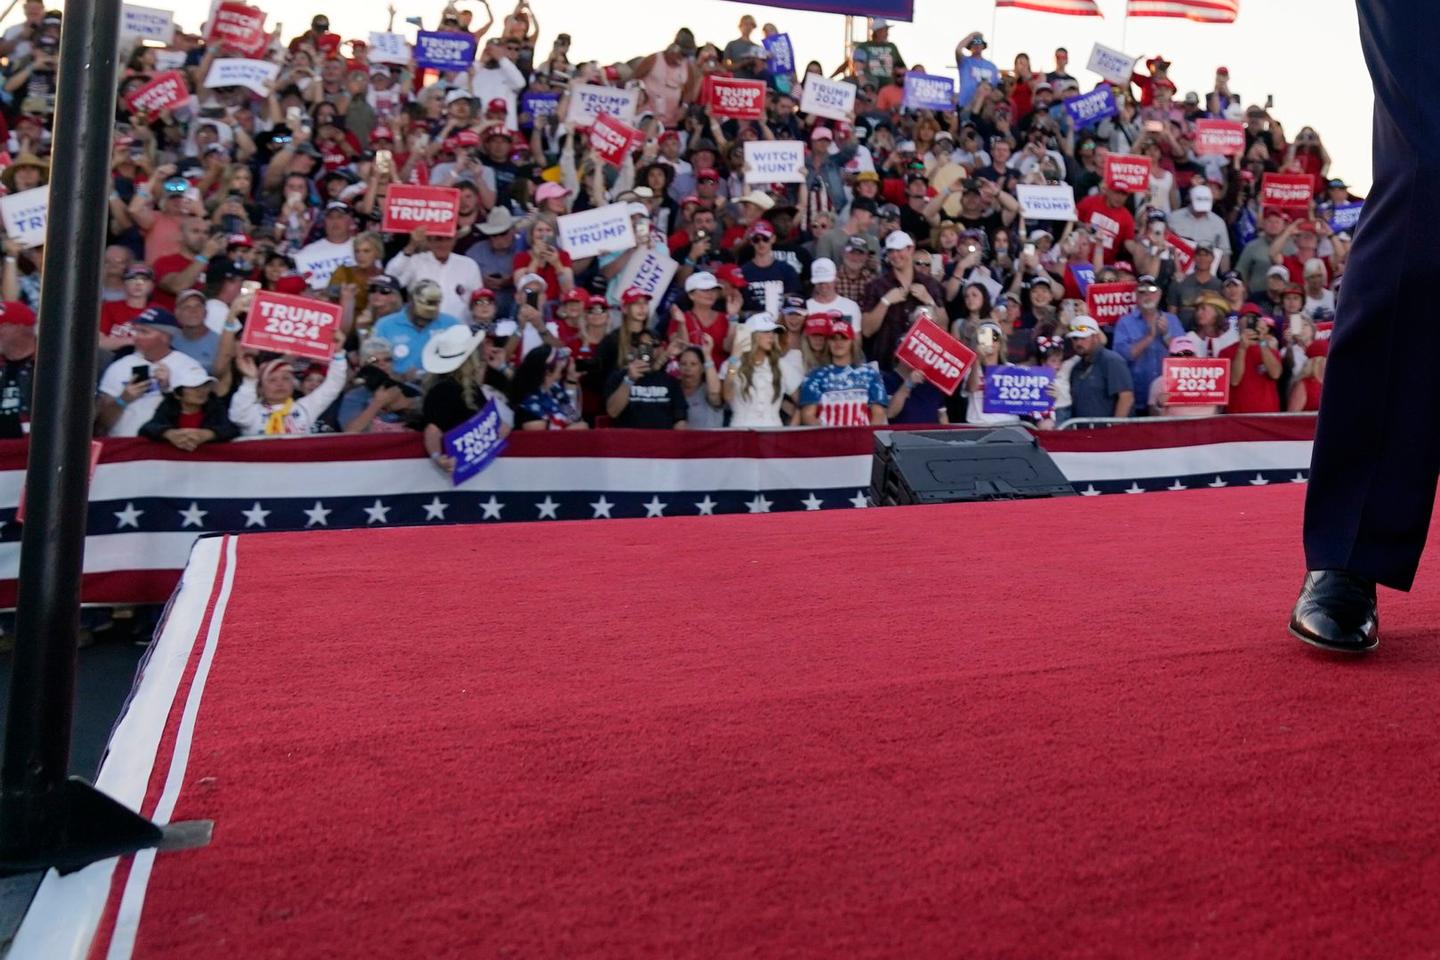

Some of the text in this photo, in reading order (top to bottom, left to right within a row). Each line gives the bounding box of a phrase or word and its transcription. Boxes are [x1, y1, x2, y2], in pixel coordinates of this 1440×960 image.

[421, 36, 470, 50] TRUMP
[425, 45, 462, 59] 2024
[812, 82, 850, 98] TRUMP
[910, 78, 952, 91] TRUMP
[714, 86, 761, 98] TRUMP
[916, 87, 946, 99] 2024
[581, 92, 630, 106] TRUMP
[720, 95, 754, 107] 2024
[815, 94, 844, 107] 2024
[1070, 90, 1109, 111] TRUMP
[584, 103, 620, 115] 2024
[1202, 133, 1243, 145] TRUMP
[753, 151, 799, 162] WITCH
[758, 162, 795, 174] HUNT
[1110, 162, 1148, 175] WITCH
[1265, 188, 1311, 201] TRUMP
[1025, 200, 1071, 210] TRUMP
[390, 206, 455, 223] TRUMP
[568, 224, 627, 246] TRUMP
[632, 253, 656, 289] ITCH
[259, 301, 334, 327] TRUMP
[264, 318, 320, 340] 2024
[907, 336, 961, 379] TRUMP
[918, 333, 944, 354] STAND
[943, 350, 965, 369] WITH
[1170, 366, 1225, 379] TRUMP
[992, 374, 1049, 388] TRUMP
[1177, 378, 1216, 391] 2024
[999, 387, 1041, 400] 2024
[452, 411, 497, 452] TRUMP
